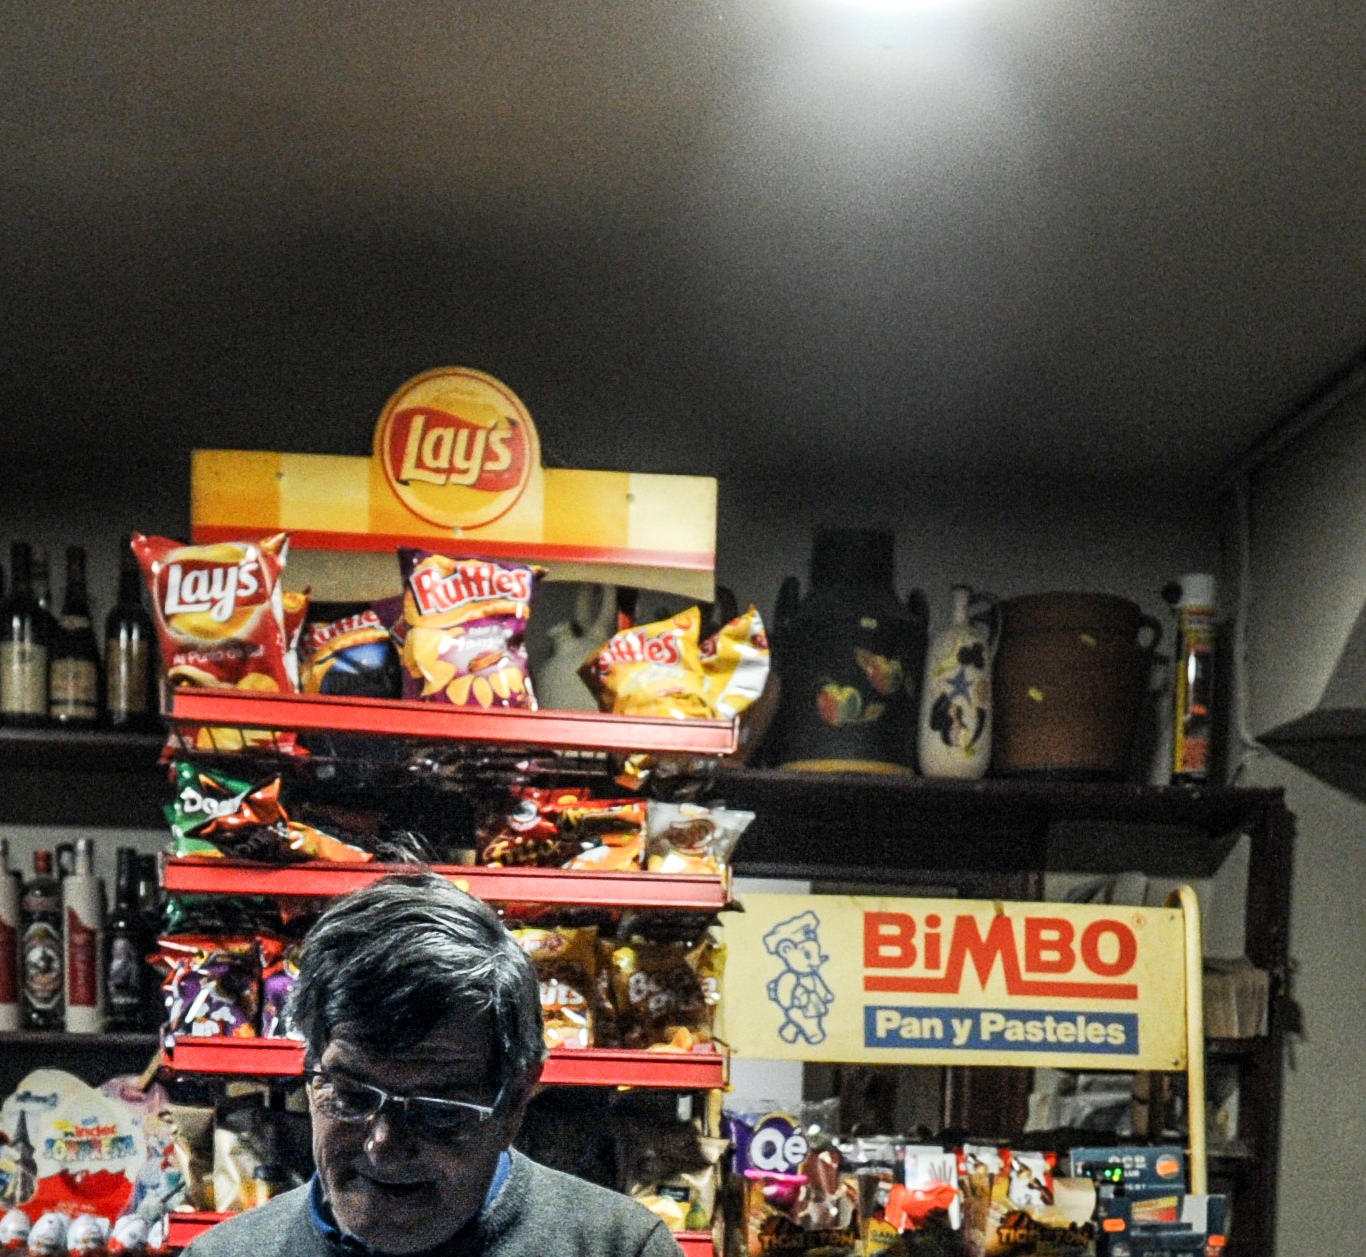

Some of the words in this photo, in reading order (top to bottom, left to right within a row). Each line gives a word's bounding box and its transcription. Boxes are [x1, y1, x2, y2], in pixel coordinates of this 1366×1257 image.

[399, 414, 514, 487] Lay's
[164, 562, 260, 623] Lay's
[411, 563, 530, 614] Ruffles
[875, 1009, 944, 1040] Pan
[952, 1018, 973, 1046] y
[980, 1012, 1127, 1045] Pasteles
[749, 1127, 809, 1172] Qé
